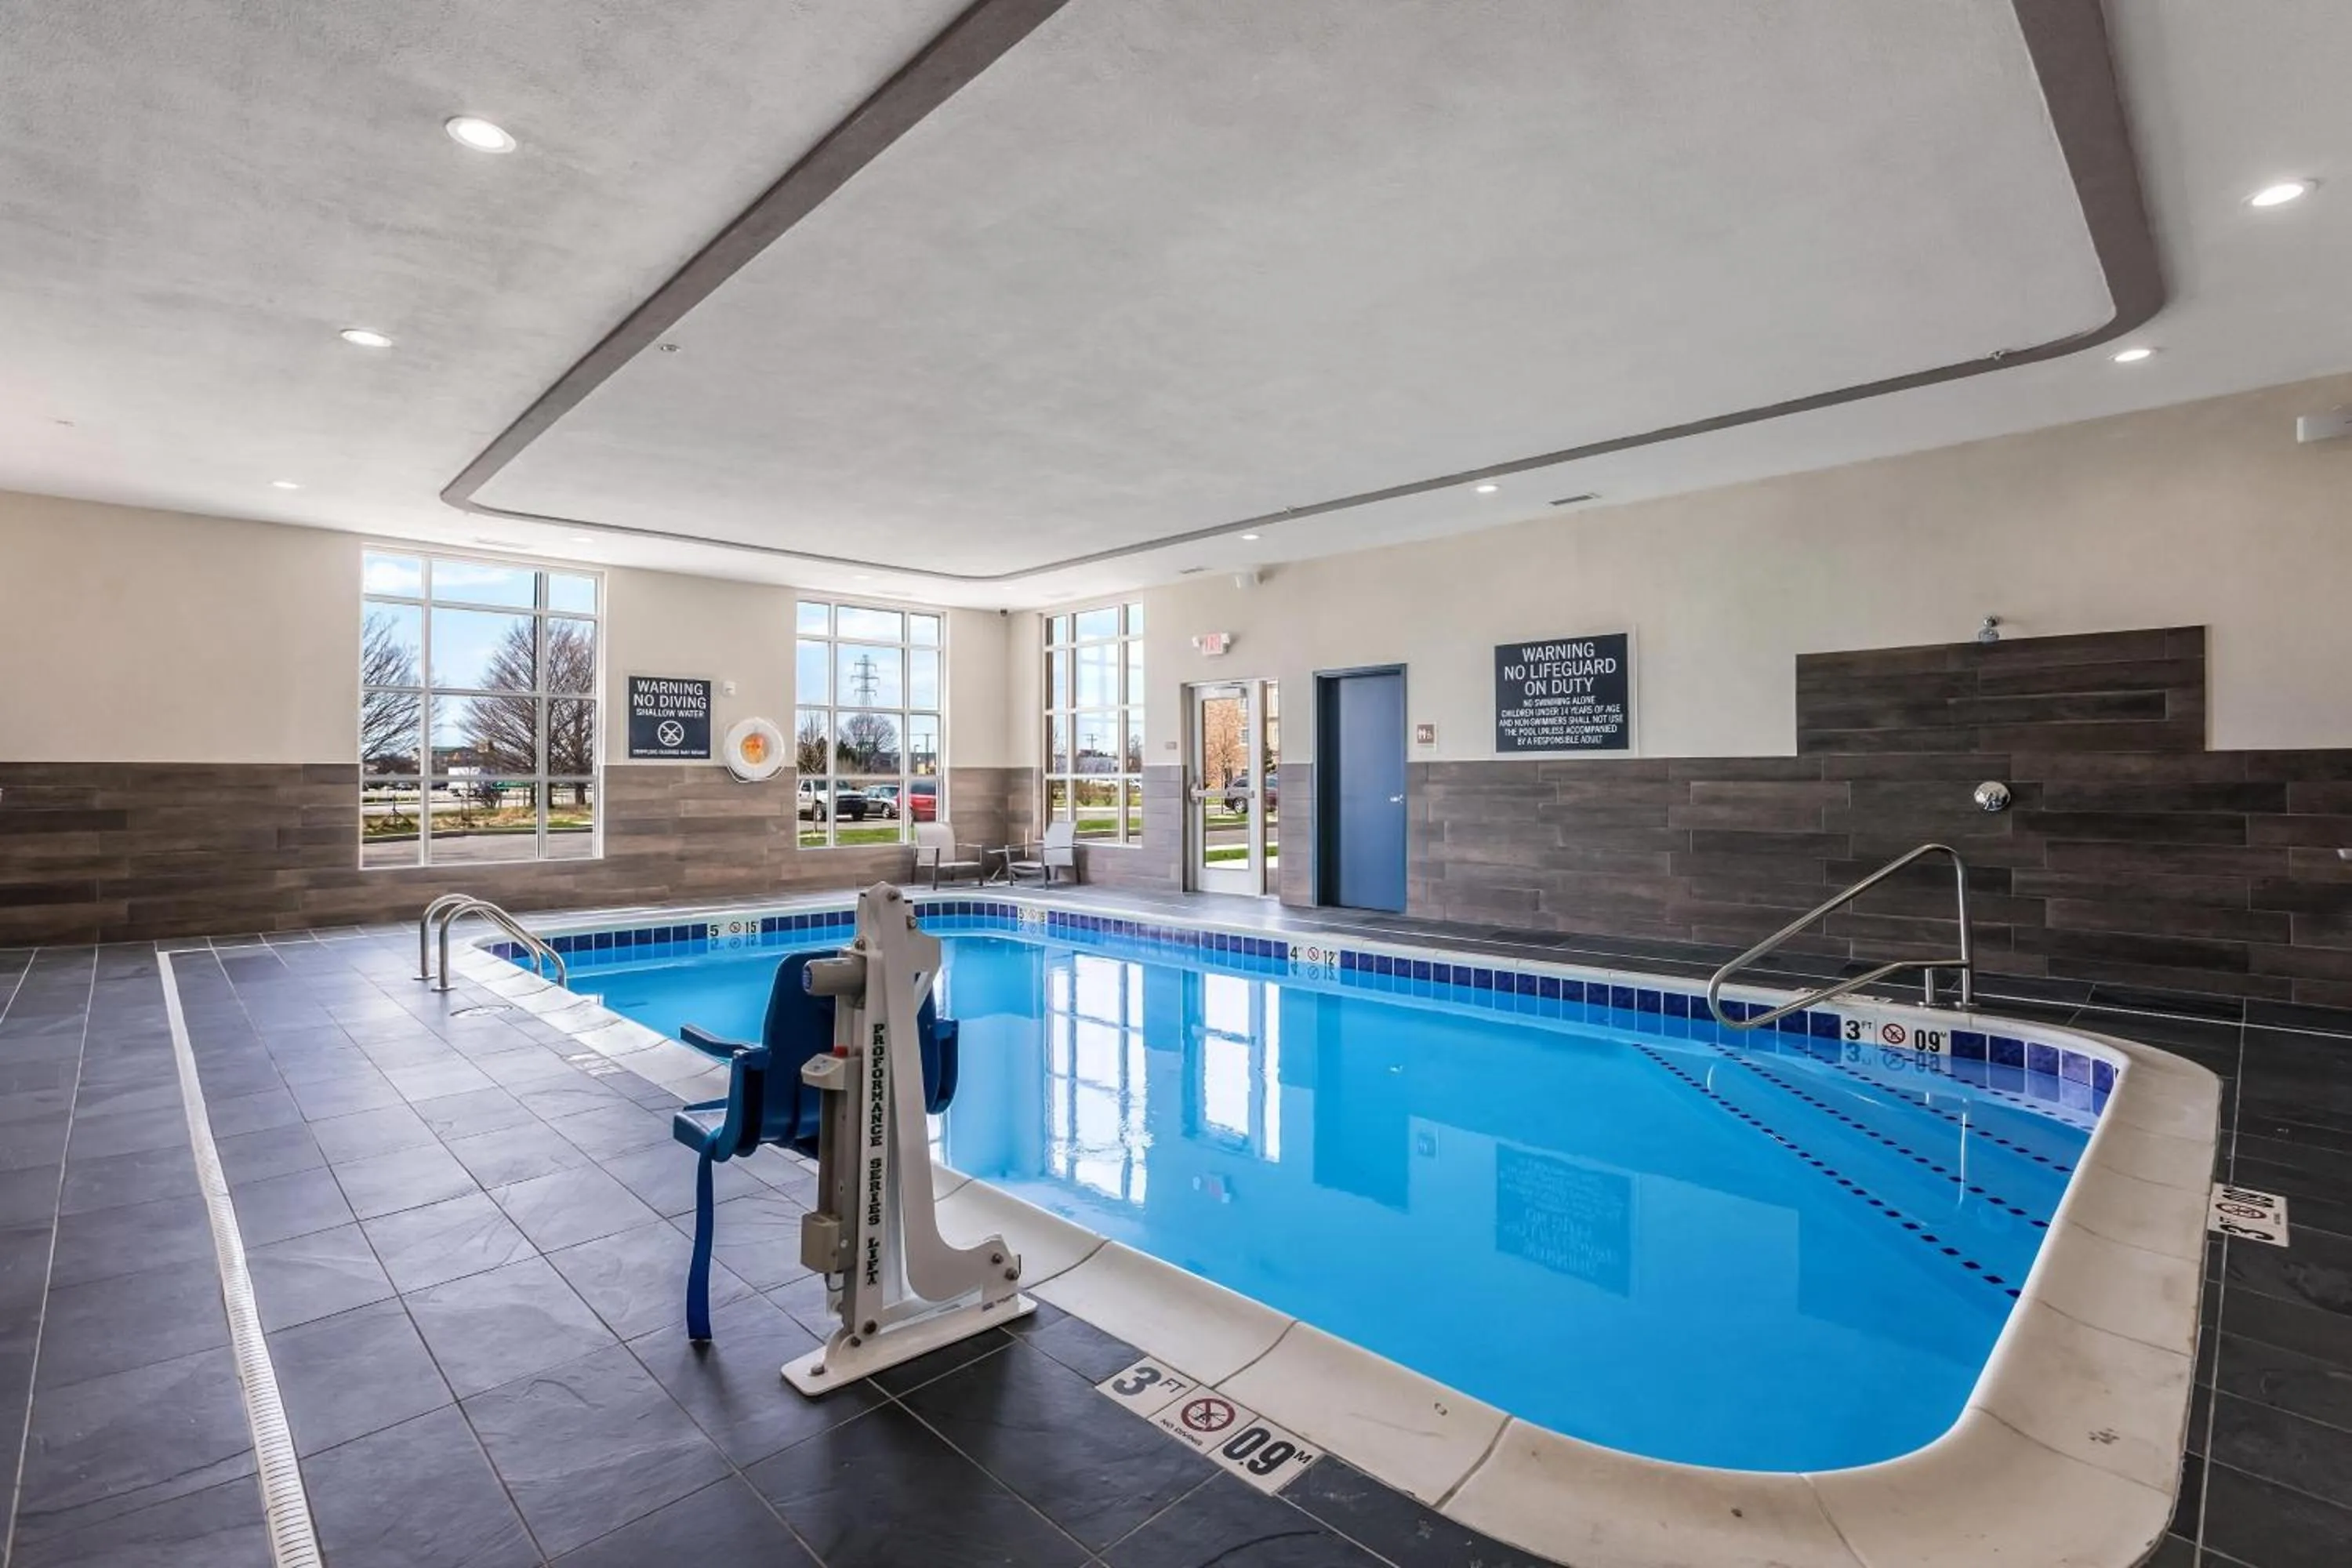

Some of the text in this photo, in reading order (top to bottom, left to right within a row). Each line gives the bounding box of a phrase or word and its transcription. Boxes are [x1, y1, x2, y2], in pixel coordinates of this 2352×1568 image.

[1522, 642, 1595, 662] WARNING
[1504, 658, 1617, 681] NO LIFEGUARD
[637, 680, 703, 695] WARNING
[1524, 677, 1594, 695] ON DUTY
[633, 694, 706, 710] NO DIVING
[1523, 699, 1534, 707] NO
[1572, 695, 1596, 705] ALONE
[636, 708, 705, 718] SHALLOW WATER
[1501, 709, 1534, 717] CHILDREN
[1535, 707, 1559, 717] UNDER
[1570, 706, 1593, 714] YEARS
[1595, 705, 1605, 713] OF
[1605, 703, 1621, 713] AGE
[1499, 719, 1514, 728] AND
[1569, 714, 1590, 724] SHALL
[1592, 714, 1608, 724] NOT
[1608, 713, 1624, 724] USE
[1504, 724, 1617, 736] THE POOL UNLESS ACCOMPANIED
[1517, 735, 1603, 746] BY A RESPONSIBLE ADULT
[710, 924, 719, 937] 5
[1290, 946, 1298, 960] 4
[1846, 1020, 1872, 1040] 3 FT
[866, 1023, 885, 1286] PROFORMANCE SERIES LIFT
[2220, 1224, 2275, 1240] 3
[1112, 1367, 1186, 1396] 3 FT
[1160, 1418, 1203, 1446] NO DIVING
[1222, 1427, 1313, 1476] 0.9 M
